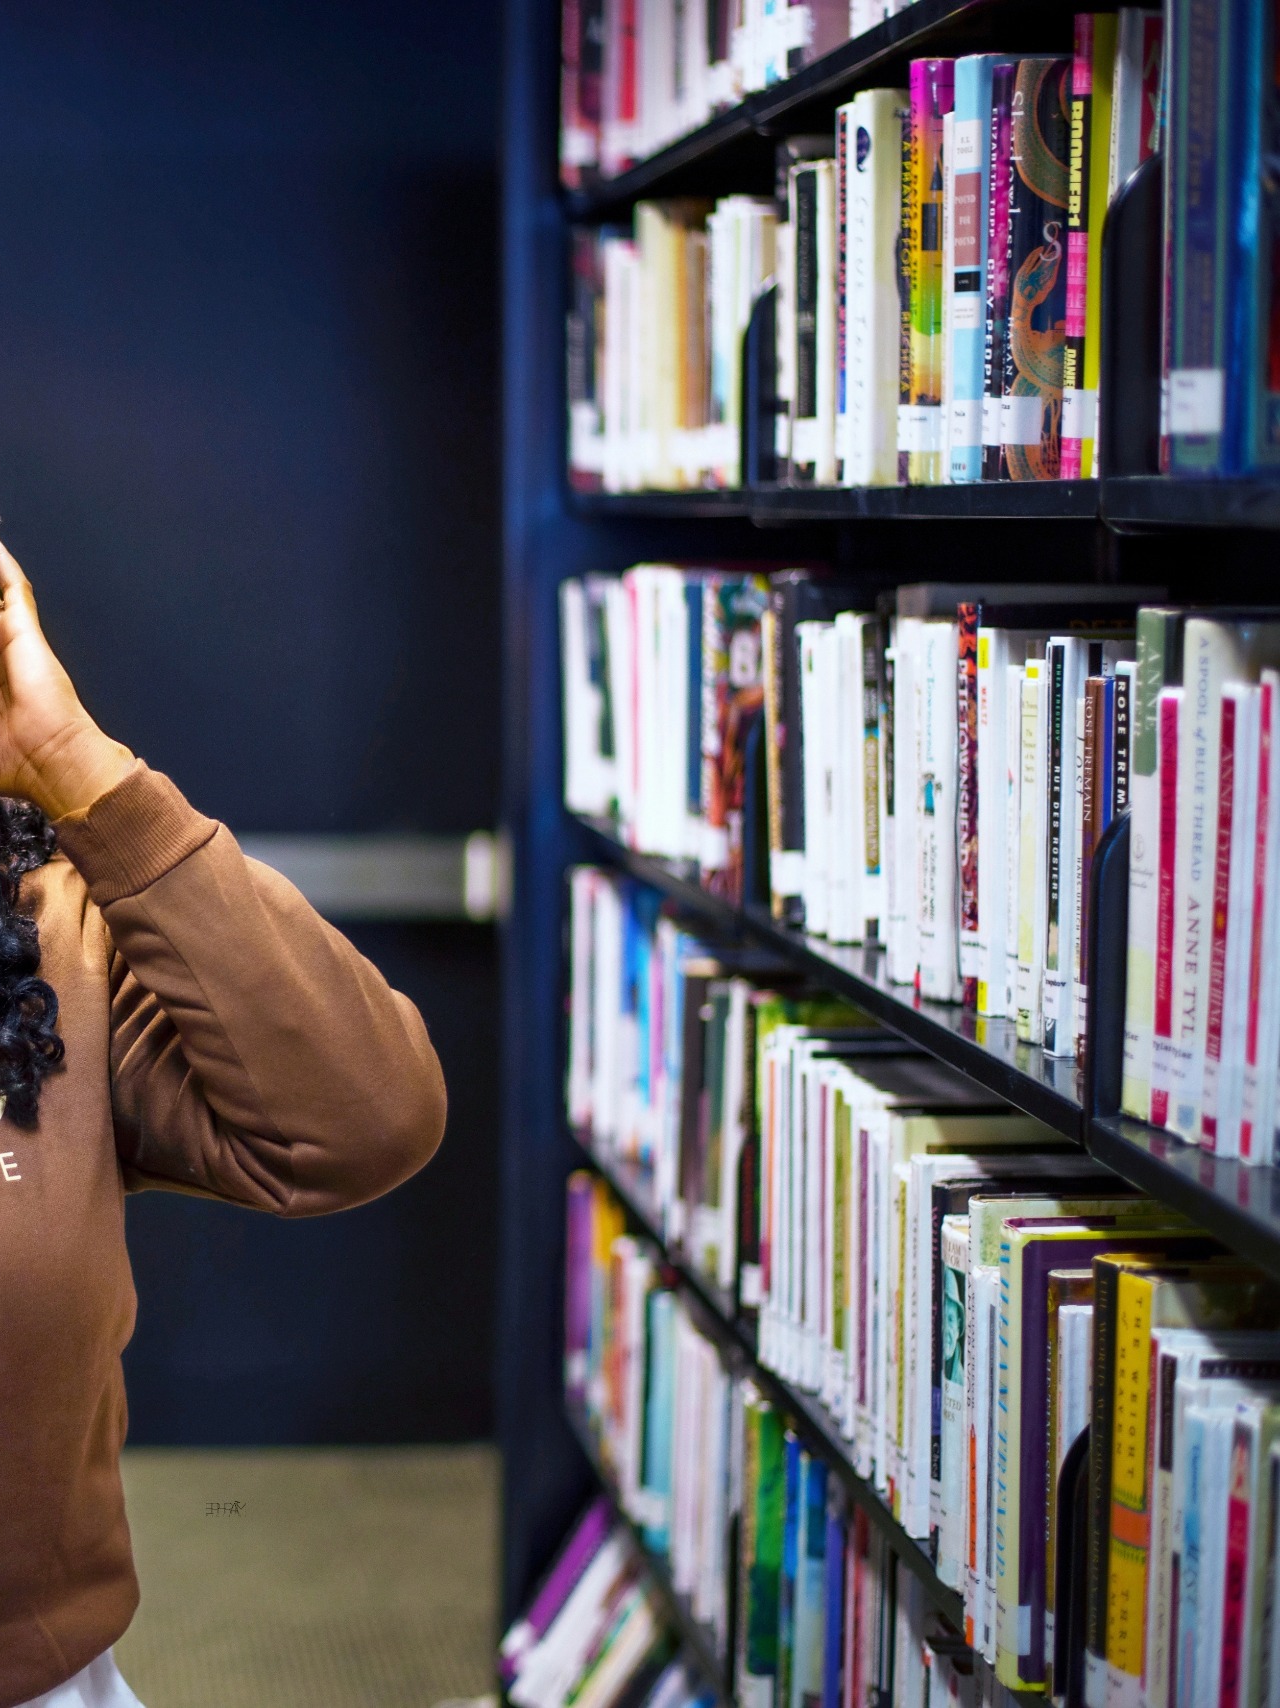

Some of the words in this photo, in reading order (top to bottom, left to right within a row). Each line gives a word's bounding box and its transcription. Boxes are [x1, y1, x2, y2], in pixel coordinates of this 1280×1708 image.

[988, 107, 999, 192] ELIZABETH
[1068, 100, 1084, 227] BOOMER1
[901, 160, 911, 230] PRAYER
[988, 199, 997, 238] TOPP
[900, 237, 911, 278] FOR
[985, 258, 995, 310] CITY
[1004, 316, 1015, 376] HASAN
[1199, 637, 1210, 651] A
[958, 658, 969, 714] PETE
[1117, 681, 1126, 734] ROSE
[1196, 656, 1210, 721] SPOOL
[1084, 695, 1094, 742] ROSE
[1193, 726, 1208, 743] of
[959, 719, 970, 868] TOWNSHEND
[1052, 765, 1061, 792] RUE
[1083, 746, 1094, 822] TREMAIN
[1116, 748, 1126, 812] TREM
[1193, 746, 1207, 795] BLUE
[1219, 750, 1234, 817] ANNE
[1052, 802, 1060, 829] DES
[1190, 802, 1206, 882] THREAD
[1051, 836, 1060, 901] ROSIERS
[1214, 828, 1231, 904] TYLER
[1159, 884, 1171, 954] Patchwork
[1184, 896, 1201, 976] ANNE
[1158, 959, 1169, 1002] Planet
[1131, 1295, 1144, 1349] THE
[1115, 1345, 1127, 1457] HEAVEN
[1126, 1369, 1140, 1481] WEIGHT
[996, 1431, 1009, 1578] TREVOR
